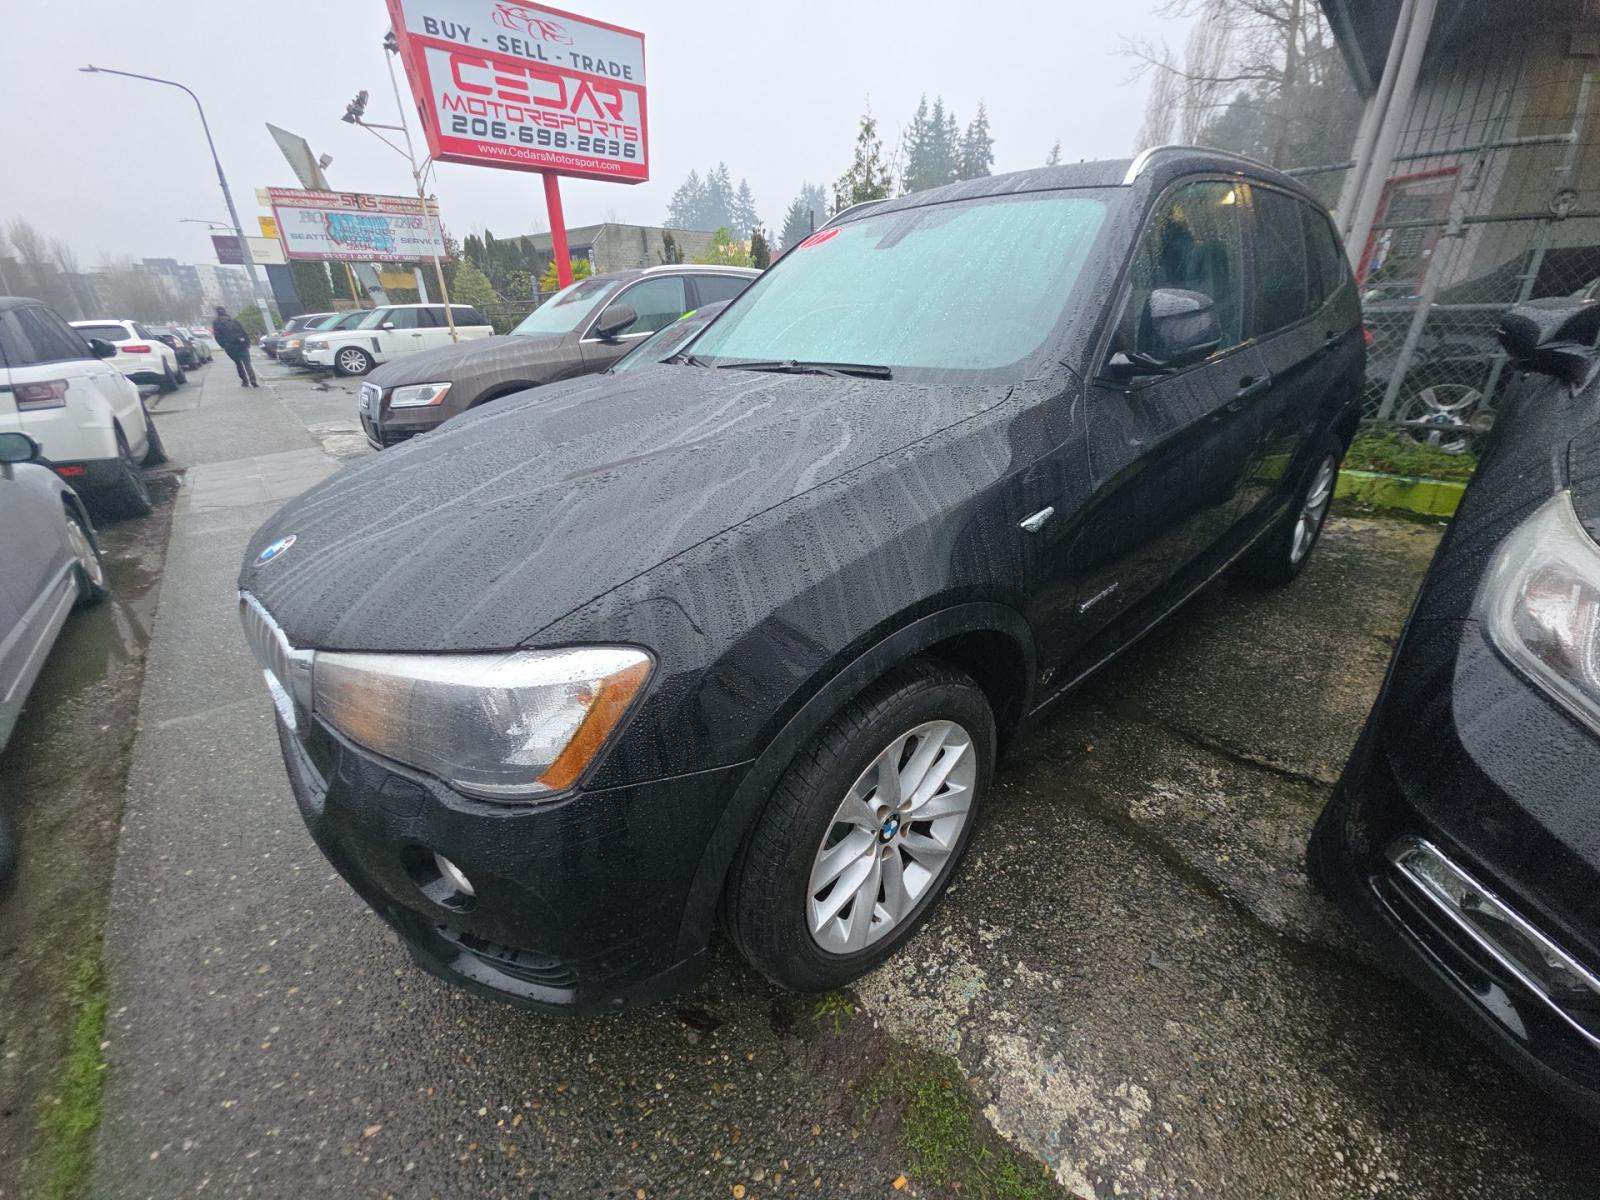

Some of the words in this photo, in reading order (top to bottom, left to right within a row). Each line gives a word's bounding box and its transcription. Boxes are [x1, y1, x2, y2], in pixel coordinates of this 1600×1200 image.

[423, 16, 471, 43] BUY
[499, 35, 548, 61] SELL
[569, 52, 632, 80] TRADE
[450, 52, 624, 121] CEDAR
[442, 92, 638, 142] MOTORSPORTS
[478, 143, 621, 171] www.CedarsMotorsport.com
